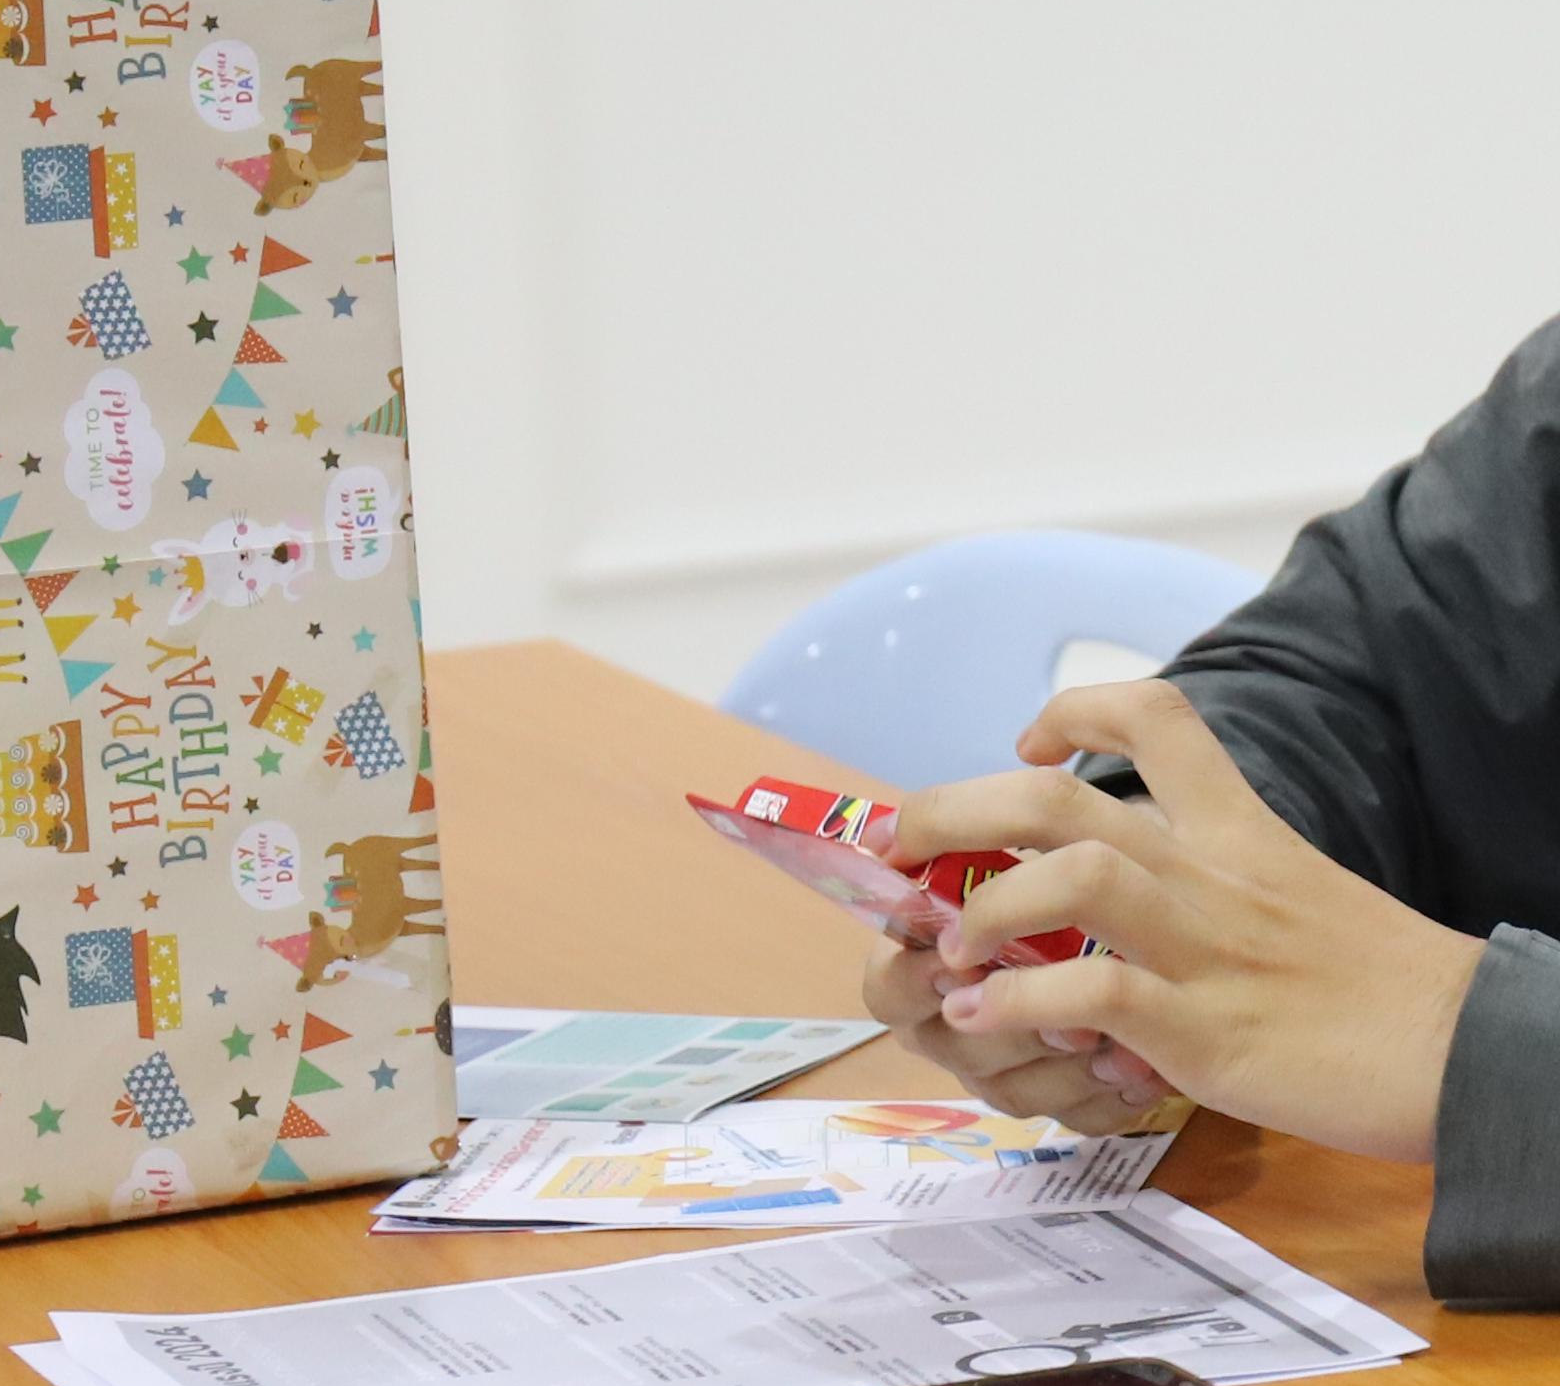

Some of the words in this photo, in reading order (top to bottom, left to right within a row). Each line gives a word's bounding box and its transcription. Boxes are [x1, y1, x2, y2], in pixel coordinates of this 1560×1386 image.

[196, 66, 215, 106] YAY
[235, 65, 254, 104] DAY
[85, 407, 101, 436] TO
[87, 440, 104, 491] TIME
[99, 388, 135, 512] celebrate!
[355, 487, 378, 558] WISH!
[100, 683, 166, 834] HAPPY
[145, 636, 230, 869] BIRTHDAY
[237, 847, 257, 886] YAY
[275, 844, 294, 884] DAY
[145, 1325, 223, 1362] 2024
